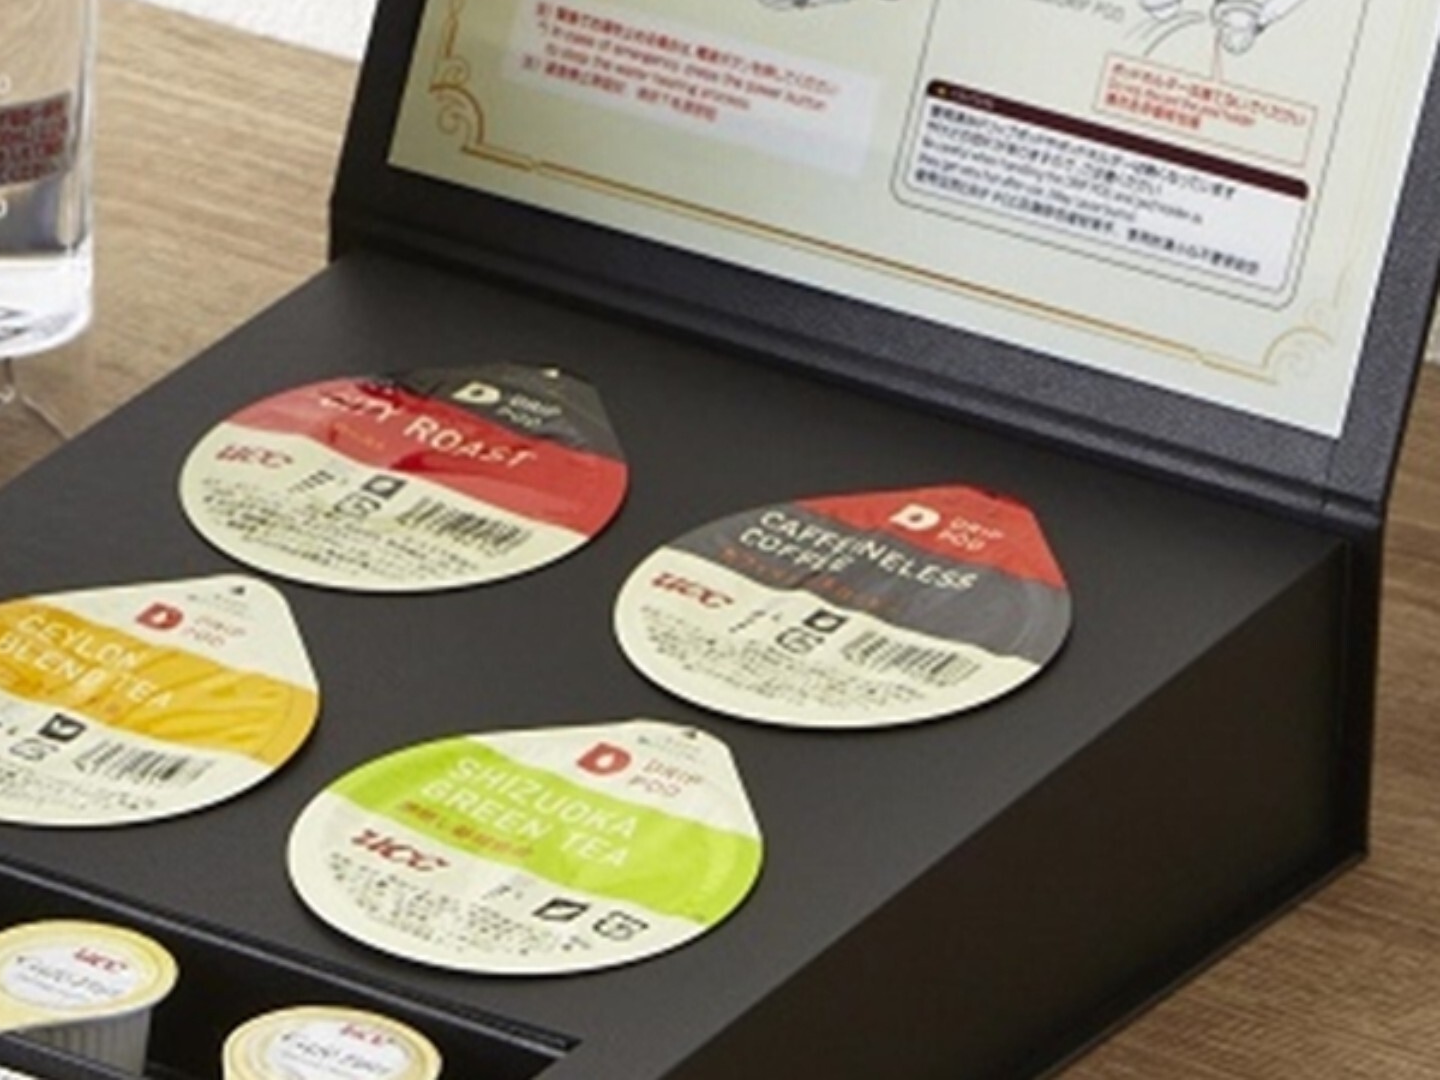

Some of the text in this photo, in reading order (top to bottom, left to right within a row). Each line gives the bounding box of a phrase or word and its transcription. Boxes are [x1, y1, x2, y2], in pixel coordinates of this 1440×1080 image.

[403, 414, 539, 470] ROAST
[19, 614, 152, 671] CEYLON
[111, 672, 177, 709] TEA
[421, 781, 554, 841] GREEN
[560, 829, 634, 869] TEA
[448, 756, 639, 839] SHIZUOKA
